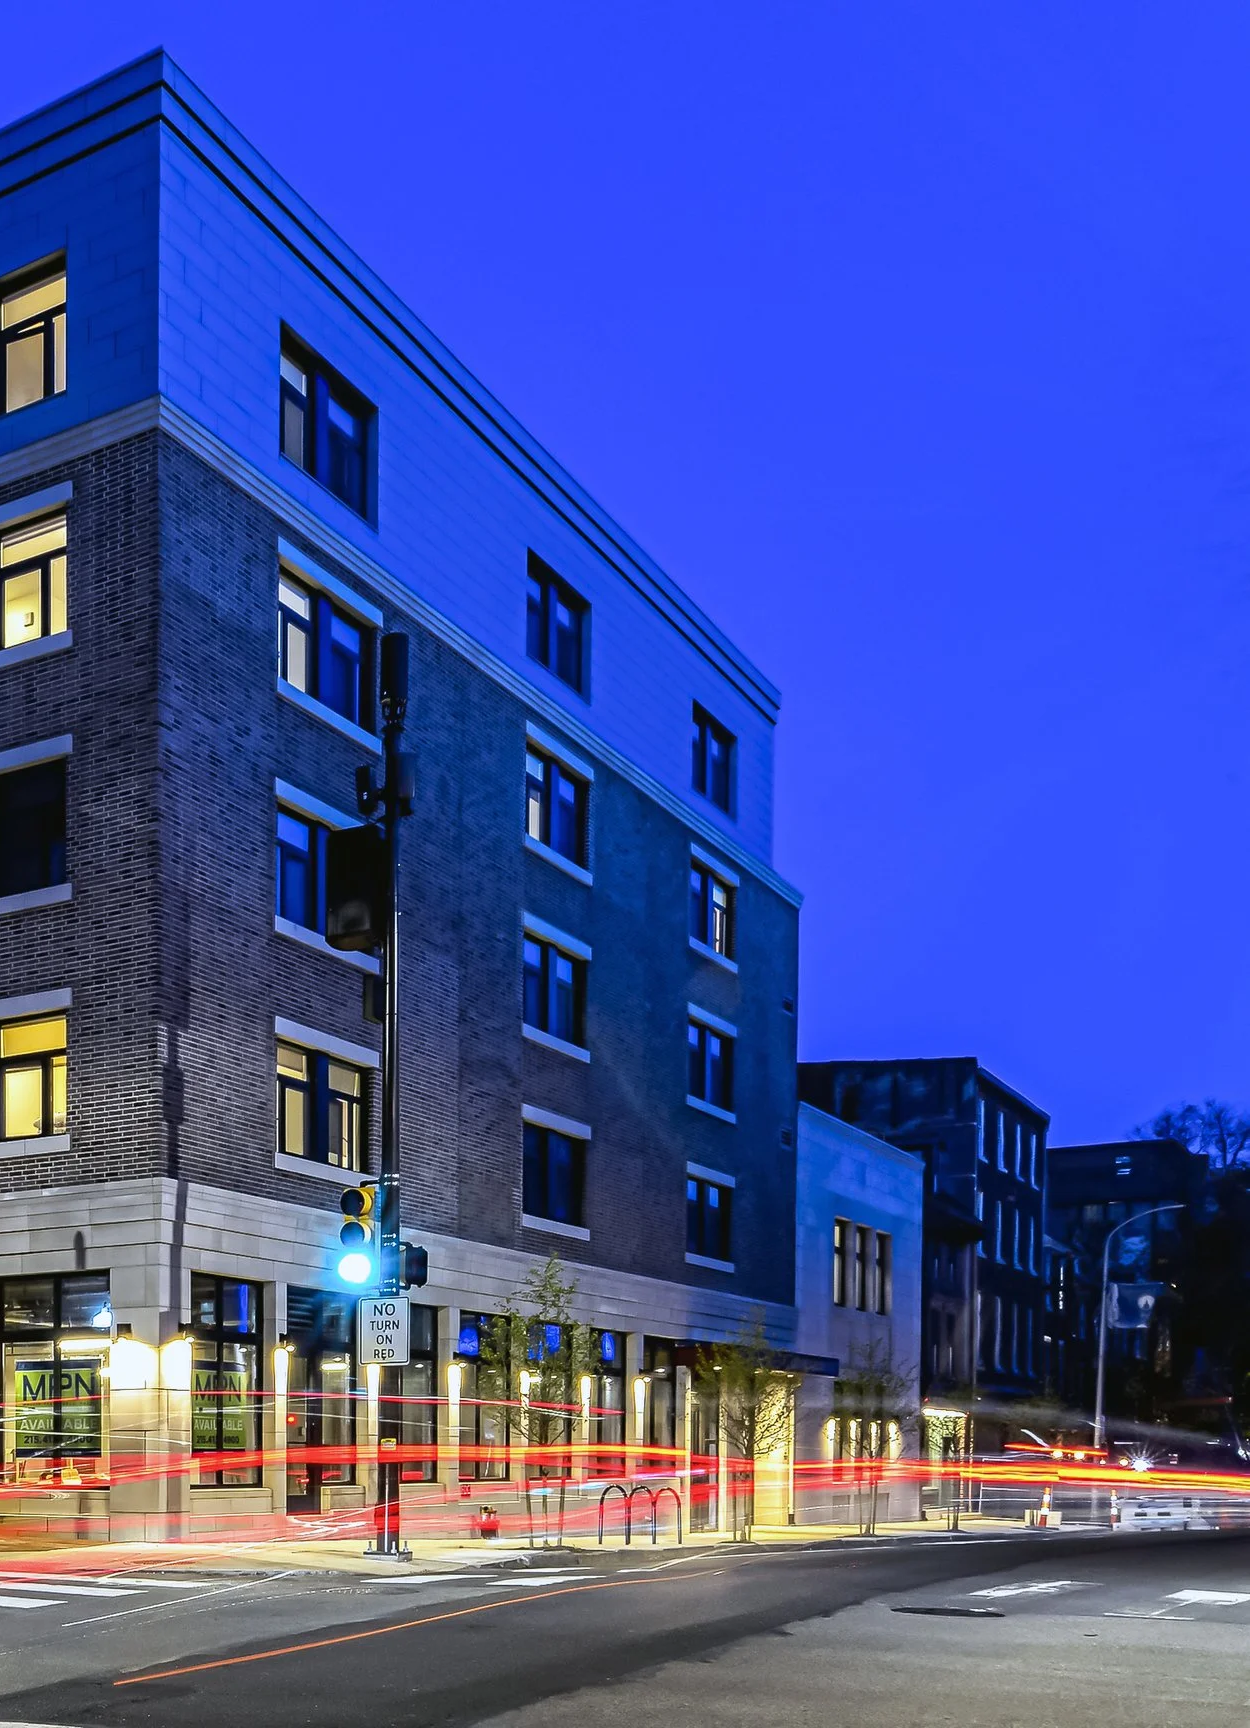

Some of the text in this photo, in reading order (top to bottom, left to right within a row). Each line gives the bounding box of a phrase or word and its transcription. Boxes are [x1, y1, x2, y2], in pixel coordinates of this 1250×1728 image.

[373, 1303, 396, 1316] NO
[369, 1320, 400, 1331] TURN
[376, 1334, 393, 1345] ON
[373, 1348, 395, 1359] RED
[22, 1372, 96, 1401] MPN
[195, 1373, 242, 1402] MPN
[20, 1418, 97, 1430] AVAIABLE
